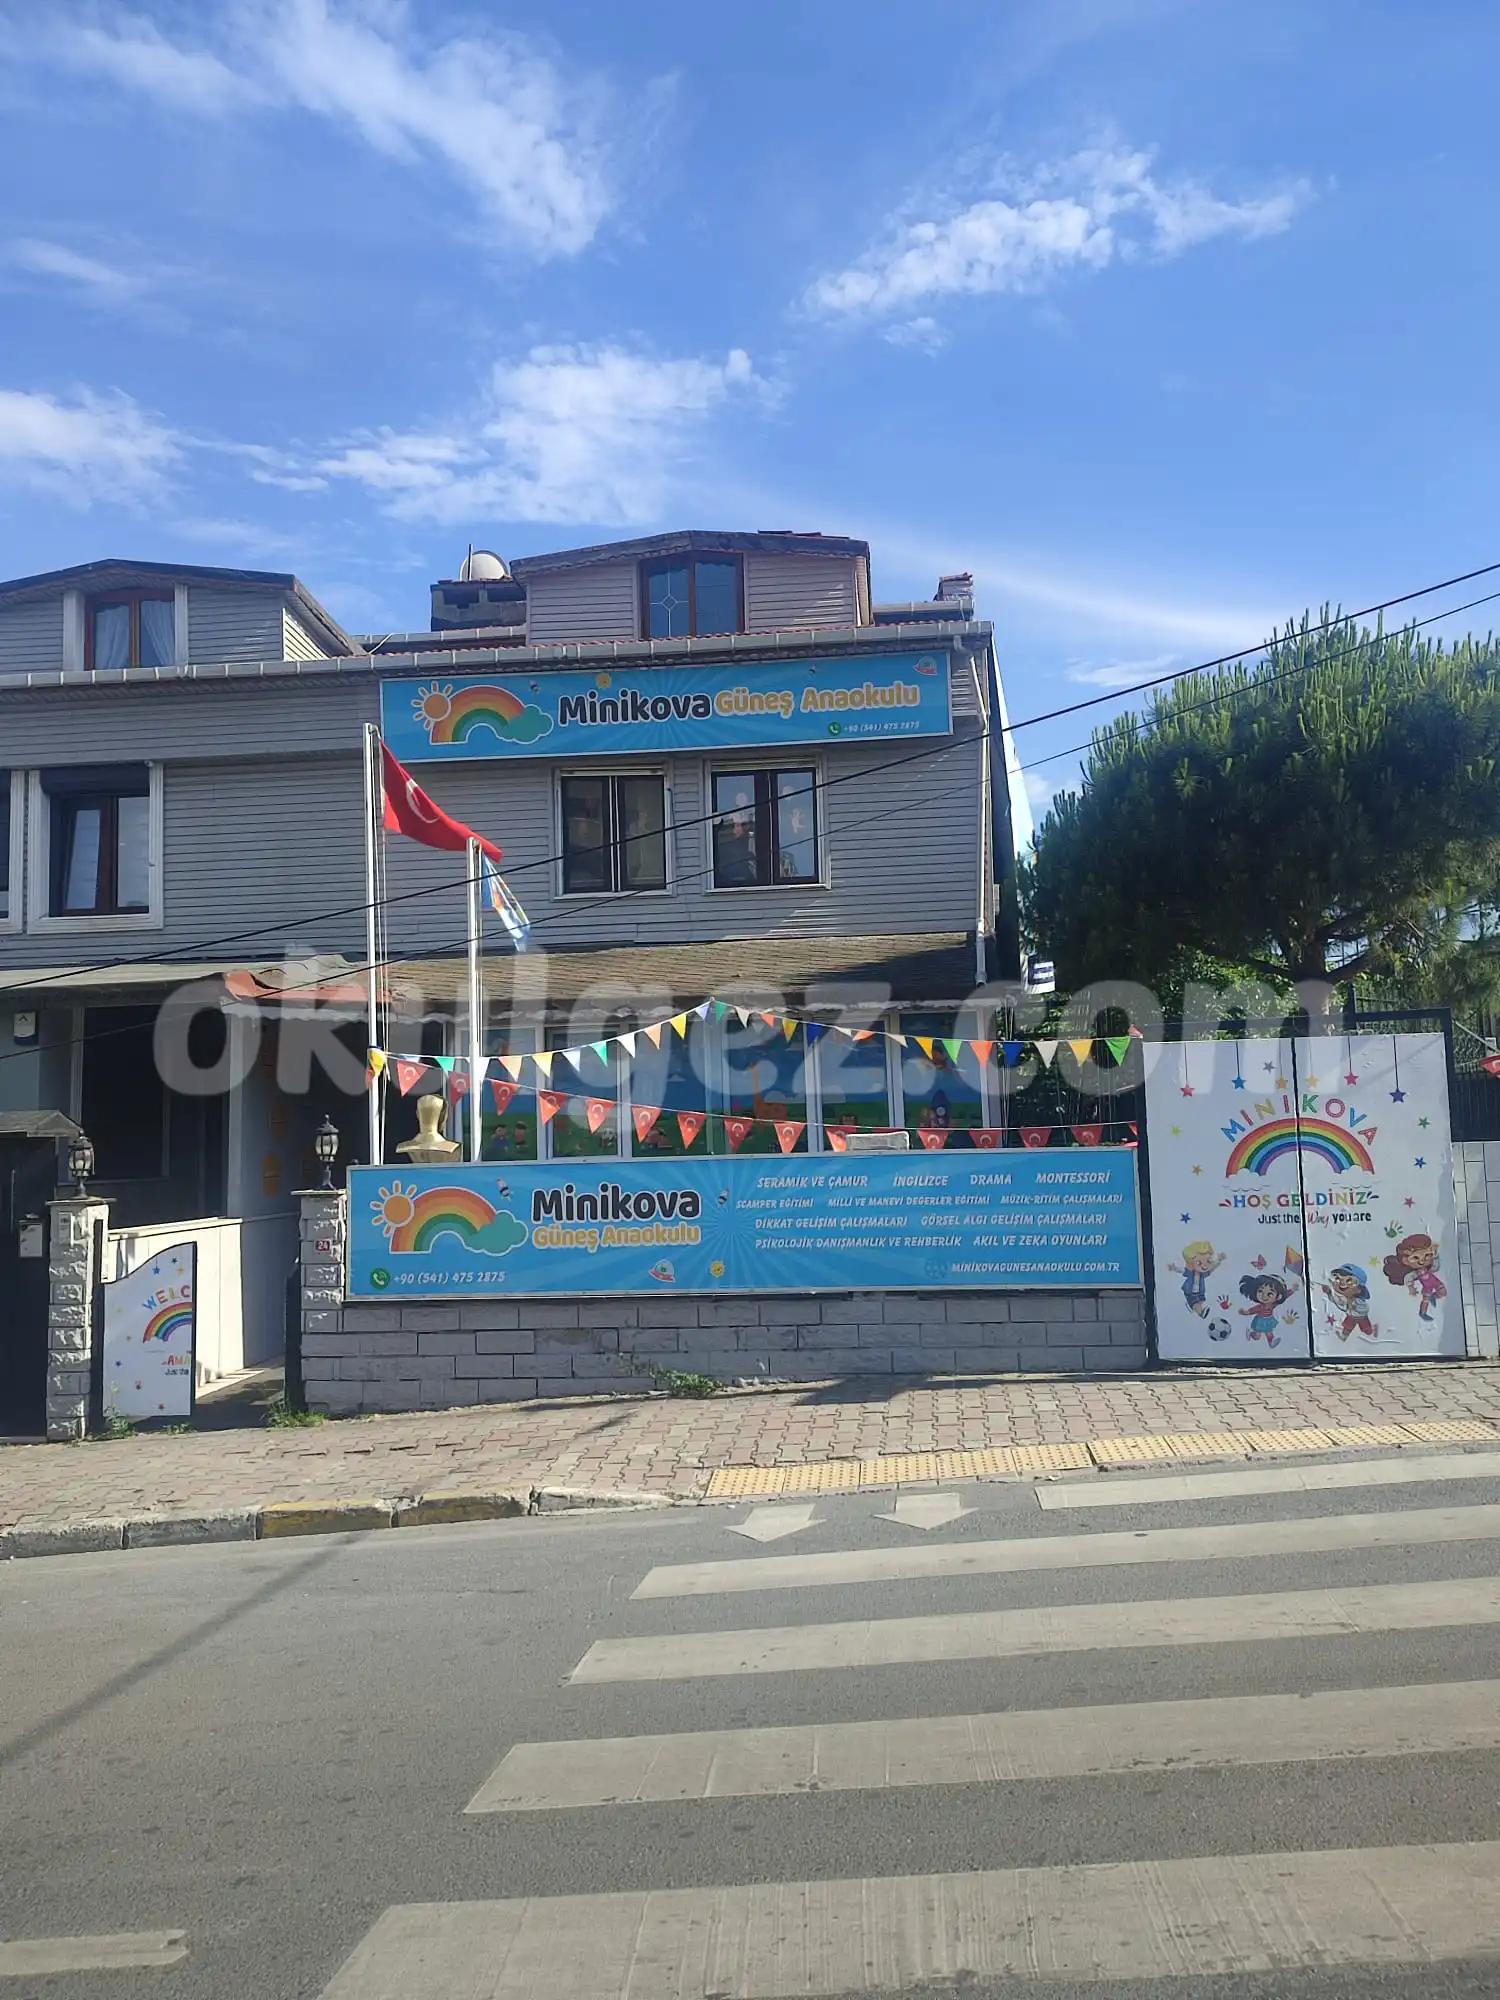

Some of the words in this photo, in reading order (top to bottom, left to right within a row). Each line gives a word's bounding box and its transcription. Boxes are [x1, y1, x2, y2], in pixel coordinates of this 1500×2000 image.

[560, 688, 711, 726] Minikova
[715, 687, 794, 718] Güneş
[801, 682, 919, 712] Anaokulu
[1220, 1094, 1378, 1146] MINIKOVA
[757, 1174, 808, 1188] SERAMİK
[812, 1175, 825, 1187] VE
[828, 1175, 868, 1189] ÇAMUR
[893, 1173, 948, 1187] İNGİLİZCE
[970, 1174, 1012, 1185] DRAMA
[1036, 1170, 1111, 1184] MONTESSORİ
[533, 1183, 700, 1222] Minikova
[736, 1199, 777, 1209] SCAMPER
[855, 1197, 866, 1206] VE
[1233, 1193, 1270, 1210] HOŞ
[1277, 1188, 1367, 1207] GELDİNİZ
[755, 1217, 793, 1229] DİKKAT
[796, 1216, 837, 1230] GELİŞİM
[840, 1216, 907, 1230] ÇALIŞMALARI
[921, 1213, 960, 1226] GÖRSEL
[963, 1214, 987, 1225] ALGI
[991, 1213, 1034, 1227] GELİŞİM
[1037, 1213, 1107, 1227] ÇALIŞMALARI
[1258, 1212, 1281, 1224] Just
[1283, 1212, 1300, 1223] the
[533, 1226, 598, 1252] Güneş
[602, 1222, 700, 1247] Anaokulu
[755, 1237, 815, 1249] PSİKOLOJİK
[816, 1237, 886, 1249] DANIŞMANLIK
[888, 1236, 901, 1247] VE
[903, 1234, 962, 1247] REHBERLİK
[973, 1234, 999, 1246] AKIL
[1002, 1234, 1016, 1246] VE
[1019, 1234, 1048, 1246] ZEKA
[1051, 1234, 1108, 1246] OYUNLARI
[394, 1273, 414, 1284] +90
[418, 1272, 449, 1285] (541)
[453, 1271, 473, 1283] 475
[477, 1270, 505, 1282] 2875
